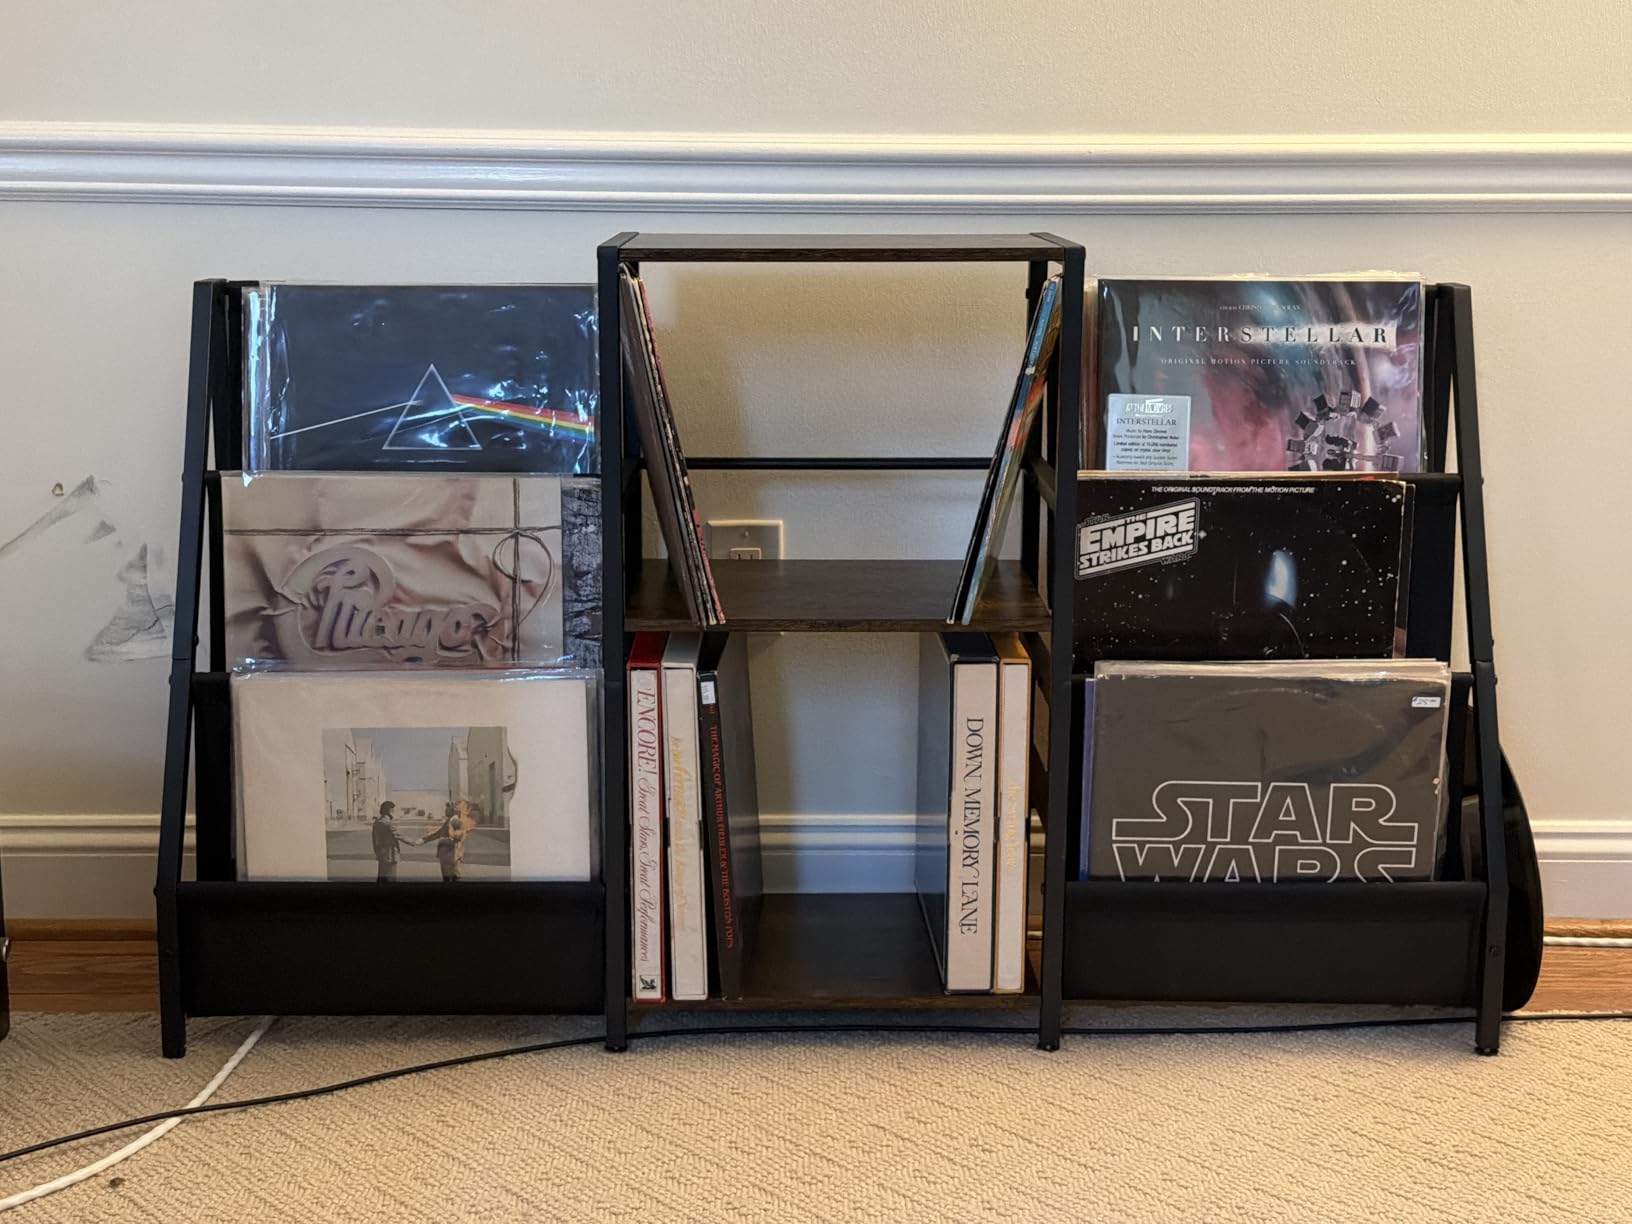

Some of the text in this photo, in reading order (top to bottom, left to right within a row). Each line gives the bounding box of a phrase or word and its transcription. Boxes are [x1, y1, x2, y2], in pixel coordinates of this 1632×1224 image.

[1132, 325, 1387, 343] INTERSTELLAR
[1160, 358, 1357, 366] ORIGINAL MOTION PICTURE SOUNDTRACK
[1116, 417, 1177, 426] INTERSTELLAR
[1192, 486, 1233, 494] SOUNDTRACK
[1079, 509, 1196, 554] EMPIRE
[1125, 513, 1147, 523] THE
[1079, 531, 1194, 569] STRIKES BACK
[710, 726, 719, 744] THE
[711, 744, 720, 773] MAGIC
[638, 777, 657, 814] Great
[713, 773, 721, 786] OF
[714, 787, 724, 822] ARTHUR
[1112, 780, 1418, 844] STAR
[959, 717, 984, 935] DOWN MEMORY LANE
[639, 851, 657, 888] Great
[1112, 844, 1416, 883] WARS
[637, 889, 657, 962] Performances
